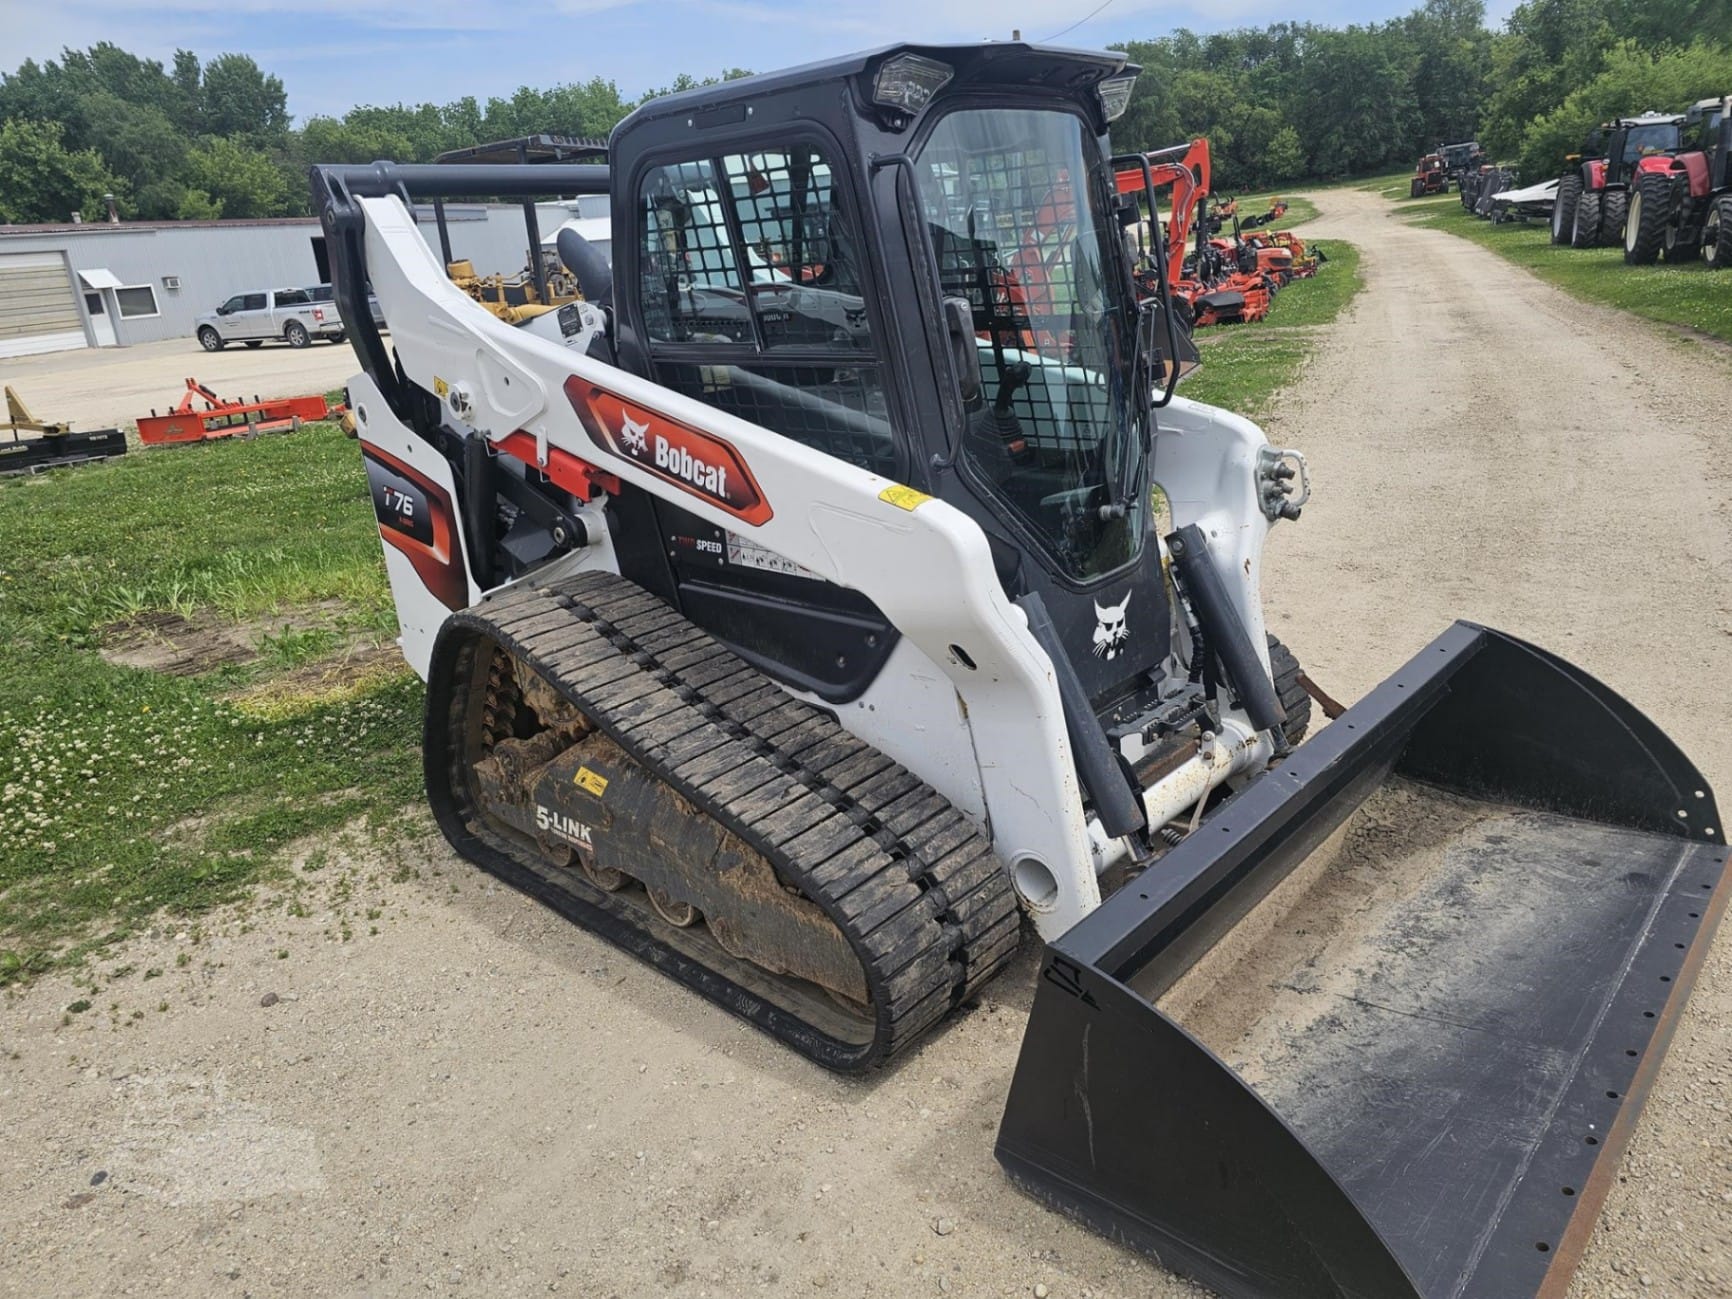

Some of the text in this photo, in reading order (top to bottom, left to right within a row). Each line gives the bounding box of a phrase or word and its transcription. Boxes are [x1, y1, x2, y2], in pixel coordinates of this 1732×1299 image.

[655, 434, 727, 498] Bobcat
[696, 539, 722, 553] SPEED
[536, 804, 592, 844] 5-LINK
